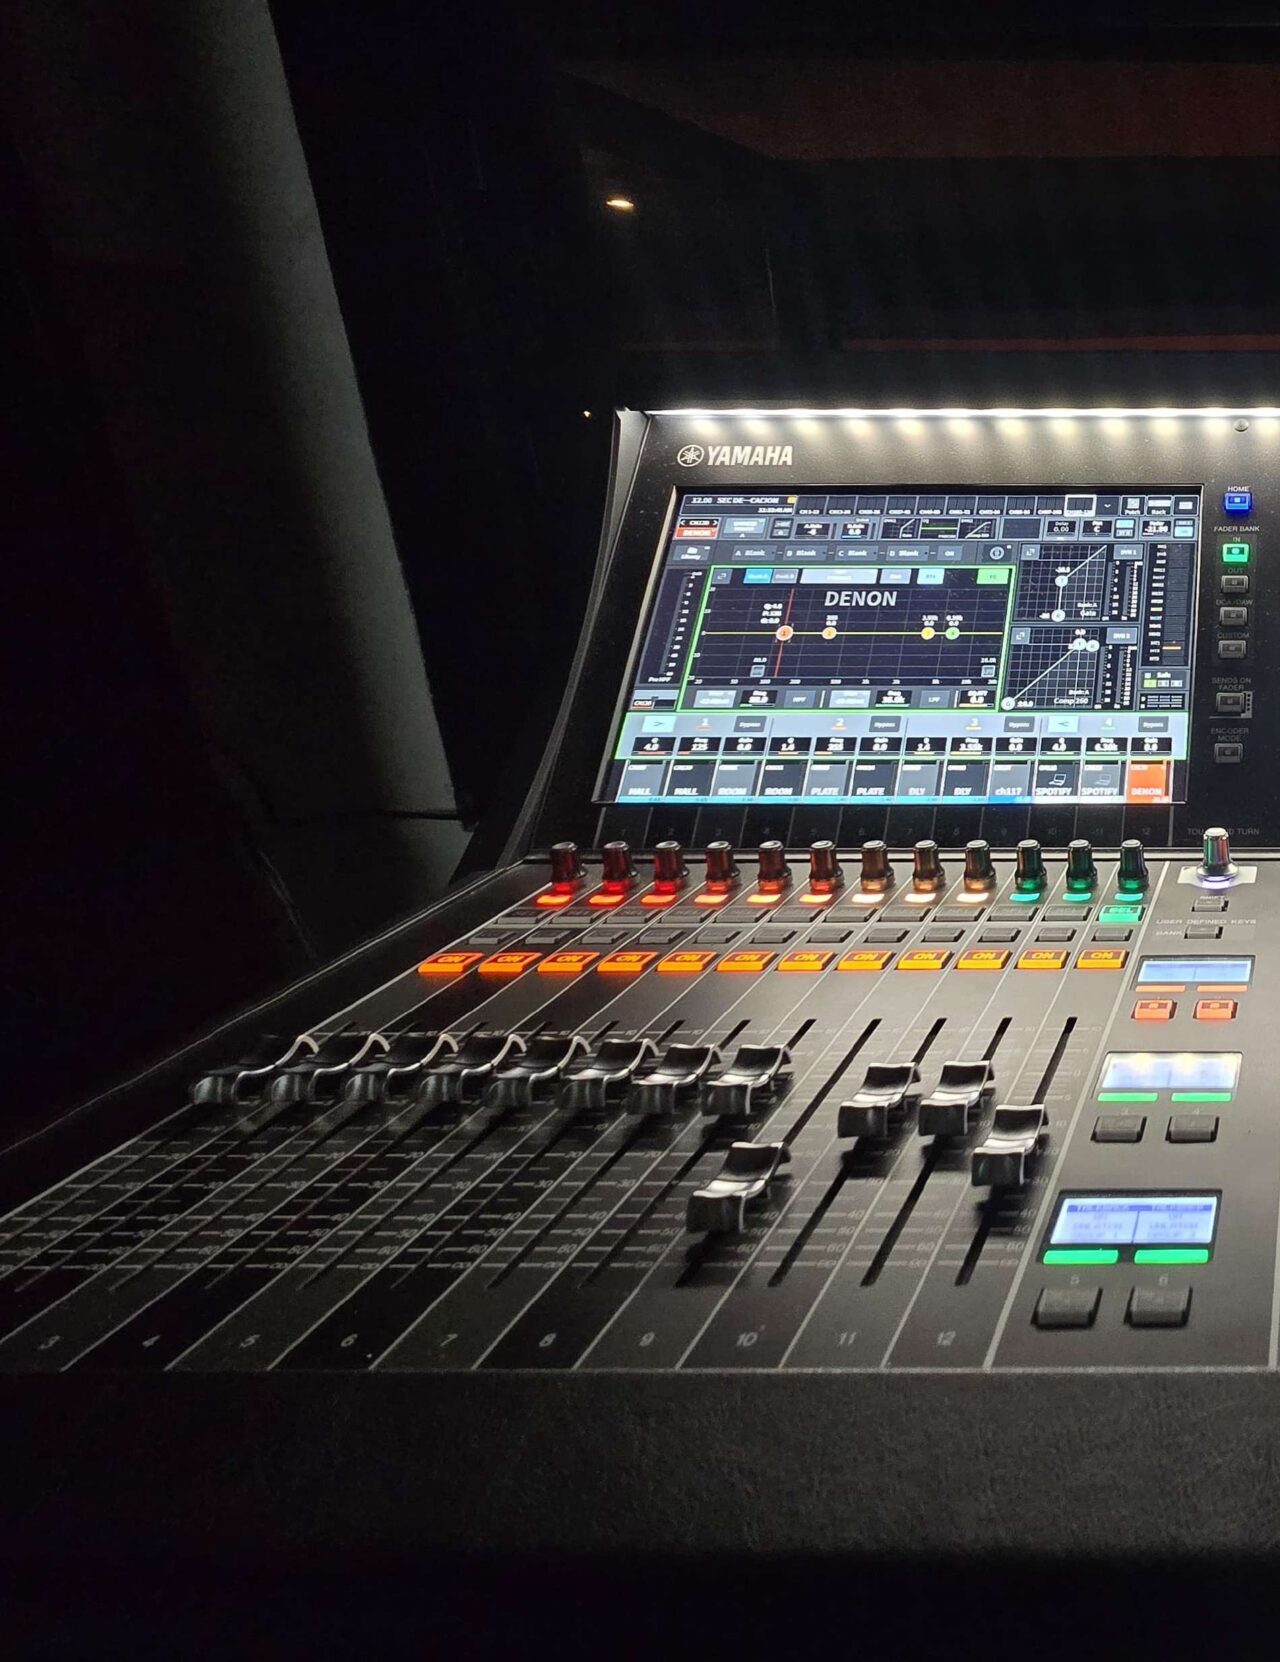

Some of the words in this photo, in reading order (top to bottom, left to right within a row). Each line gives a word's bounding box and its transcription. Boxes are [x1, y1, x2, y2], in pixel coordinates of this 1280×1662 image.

[707, 446, 793, 466] YAMAHA
[824, 591, 897, 606] DENON
[811, 787, 839, 795] PLATE
[856, 787, 885, 795] PLATE
[1035, 787, 1072, 796] SPOTIFY
[1081, 787, 1118, 796] SPOTIFY
[438, 955, 463, 963] ON
[497, 955, 523, 963] ON
[557, 955, 580, 963] ON
[616, 954, 641, 962] ON
[676, 954, 699, 962] ON
[735, 953, 759, 961] ON
[794, 952, 818, 961] ON
[853, 952, 877, 961] ON
[913, 952, 937, 960] ON
[972, 952, 996, 960] ON
[1032, 951, 1055, 960] ON
[1091, 951, 1114, 960] ON
[340, 1334, 358, 1347] 6
[639, 1333, 655, 1346] 9
[736, 1333, 758, 1346] 10
[838, 1332, 856, 1345] 11
[937, 1331, 956, 1346] 12
